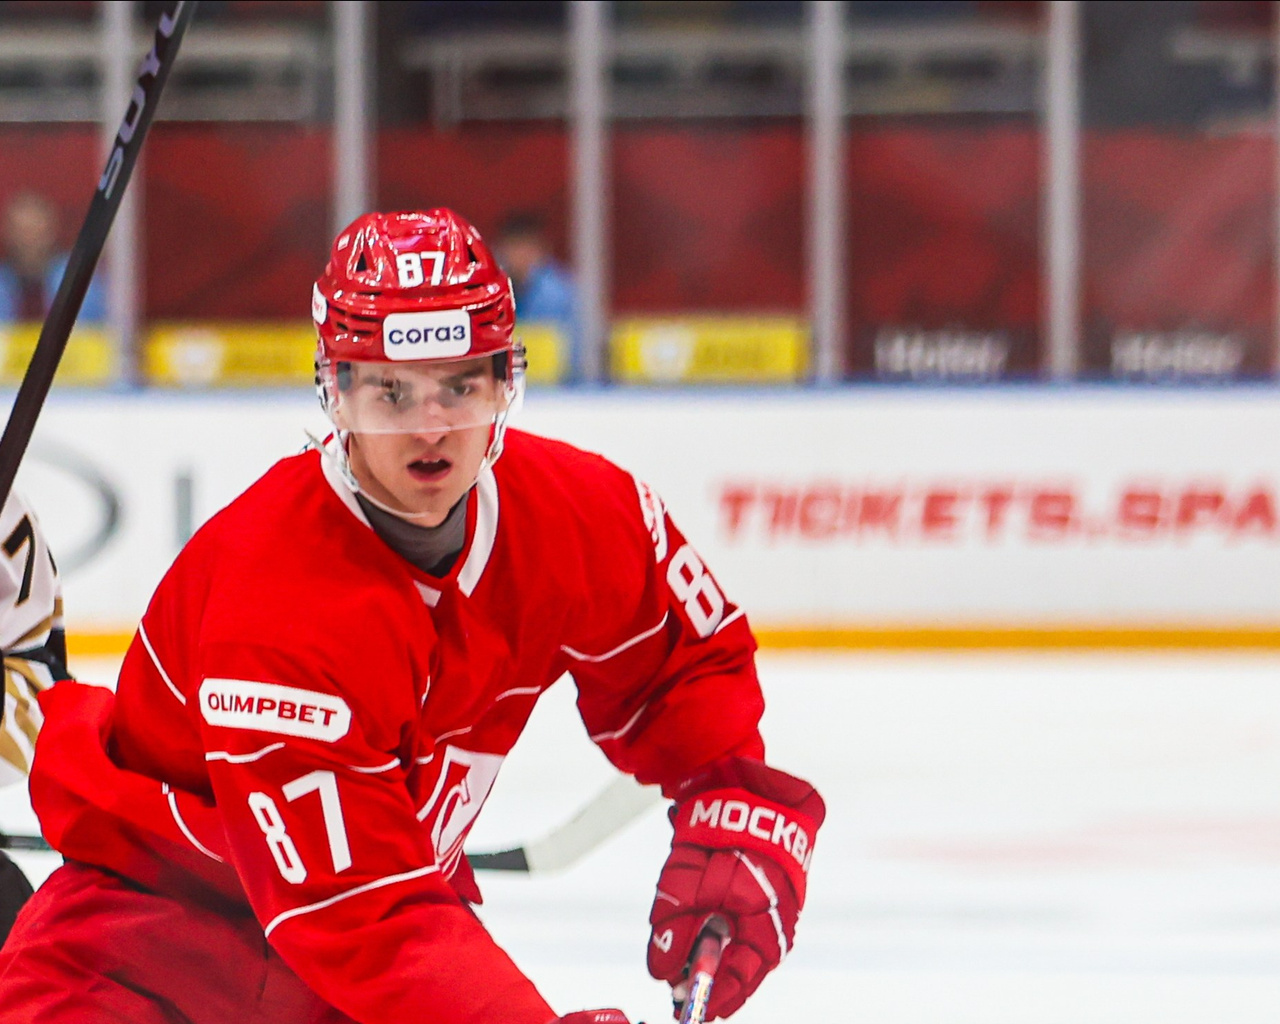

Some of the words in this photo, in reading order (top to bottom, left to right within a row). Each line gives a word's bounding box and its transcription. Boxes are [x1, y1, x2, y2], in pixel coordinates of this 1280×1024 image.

[396, 251, 446, 288] 87
[388, 324, 467, 346] согаз
[1, 513, 58, 608] 7
[666, 542, 728, 639] 8
[207, 692, 338, 727] OLIMPBET
[247, 769, 352, 885] 87
